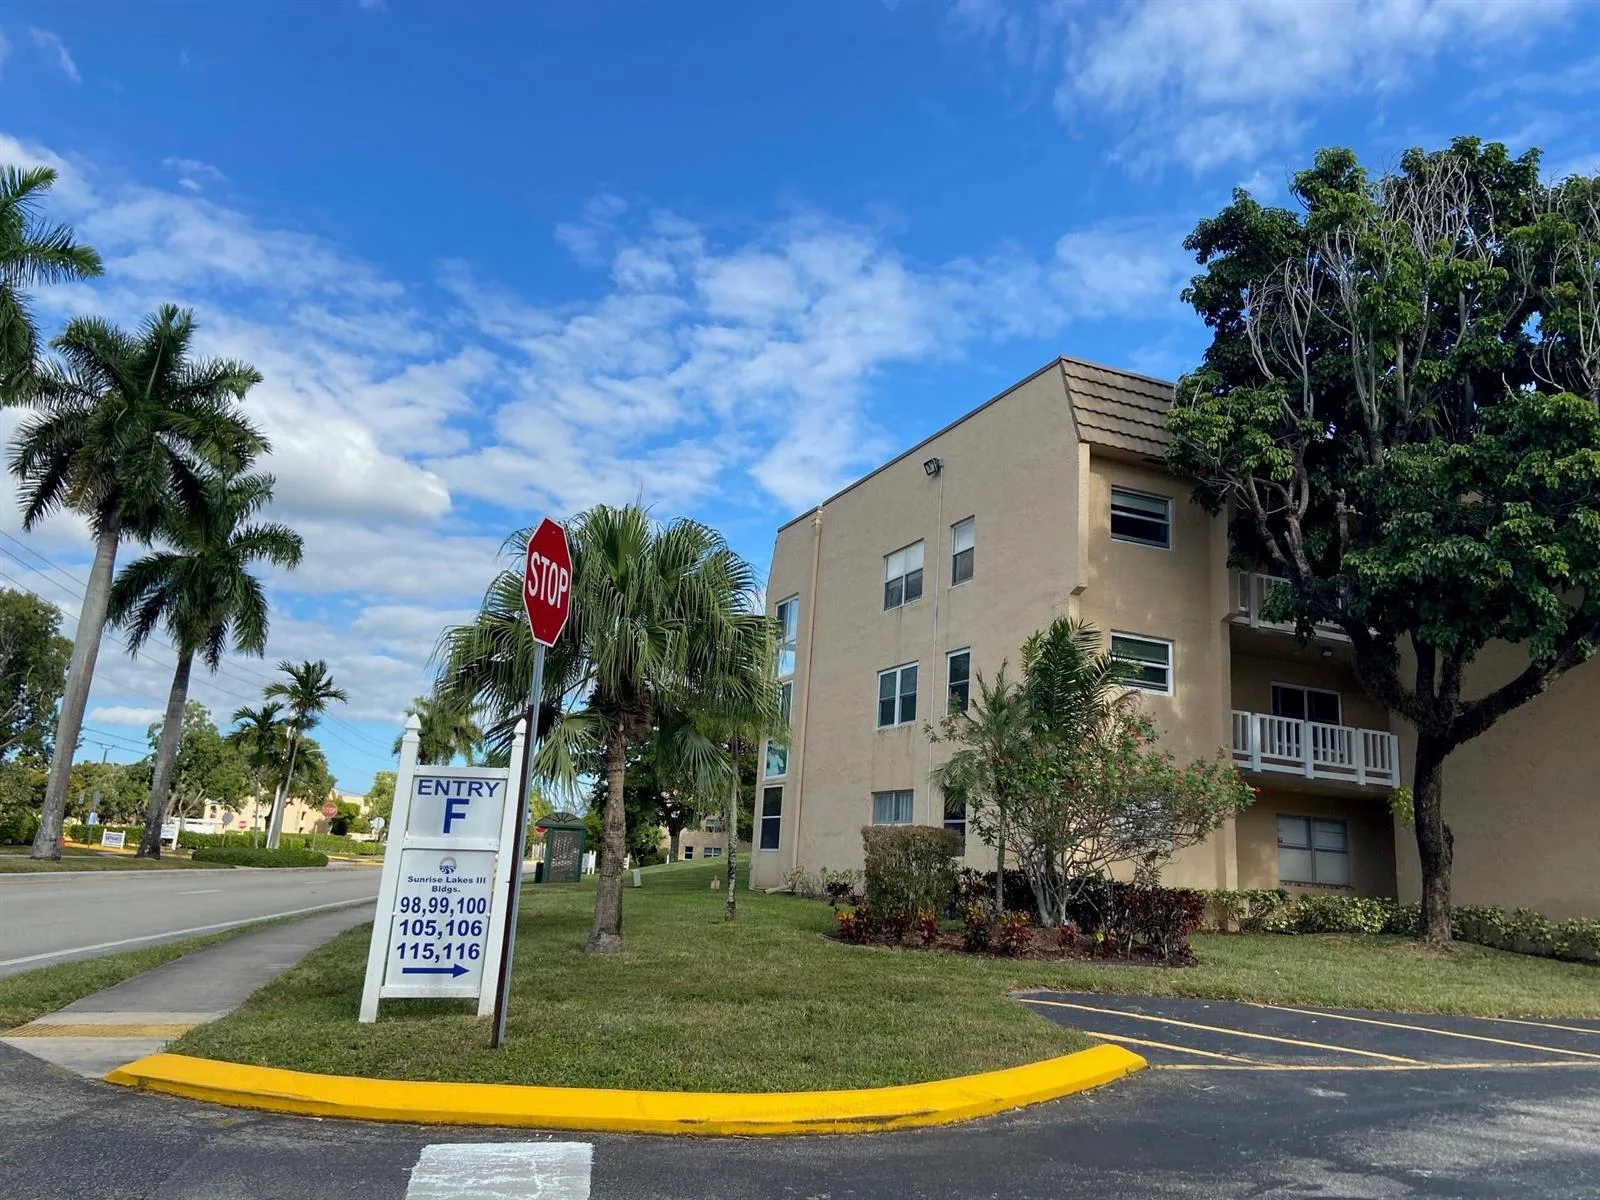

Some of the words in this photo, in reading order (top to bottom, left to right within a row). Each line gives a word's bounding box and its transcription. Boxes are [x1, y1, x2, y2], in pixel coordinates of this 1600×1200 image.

[528, 551, 569, 609] STOP
[417, 779, 500, 797] ENTRY
[443, 798, 470, 834] F
[407, 875, 443, 884] Sunrise
[446, 876, 473, 884] Lakes
[431, 885, 461, 894] Bldgs.
[400, 896, 487, 917] 98,99,100
[399, 919, 483, 940] 105,106
[396, 942, 481, 963] 115,116
